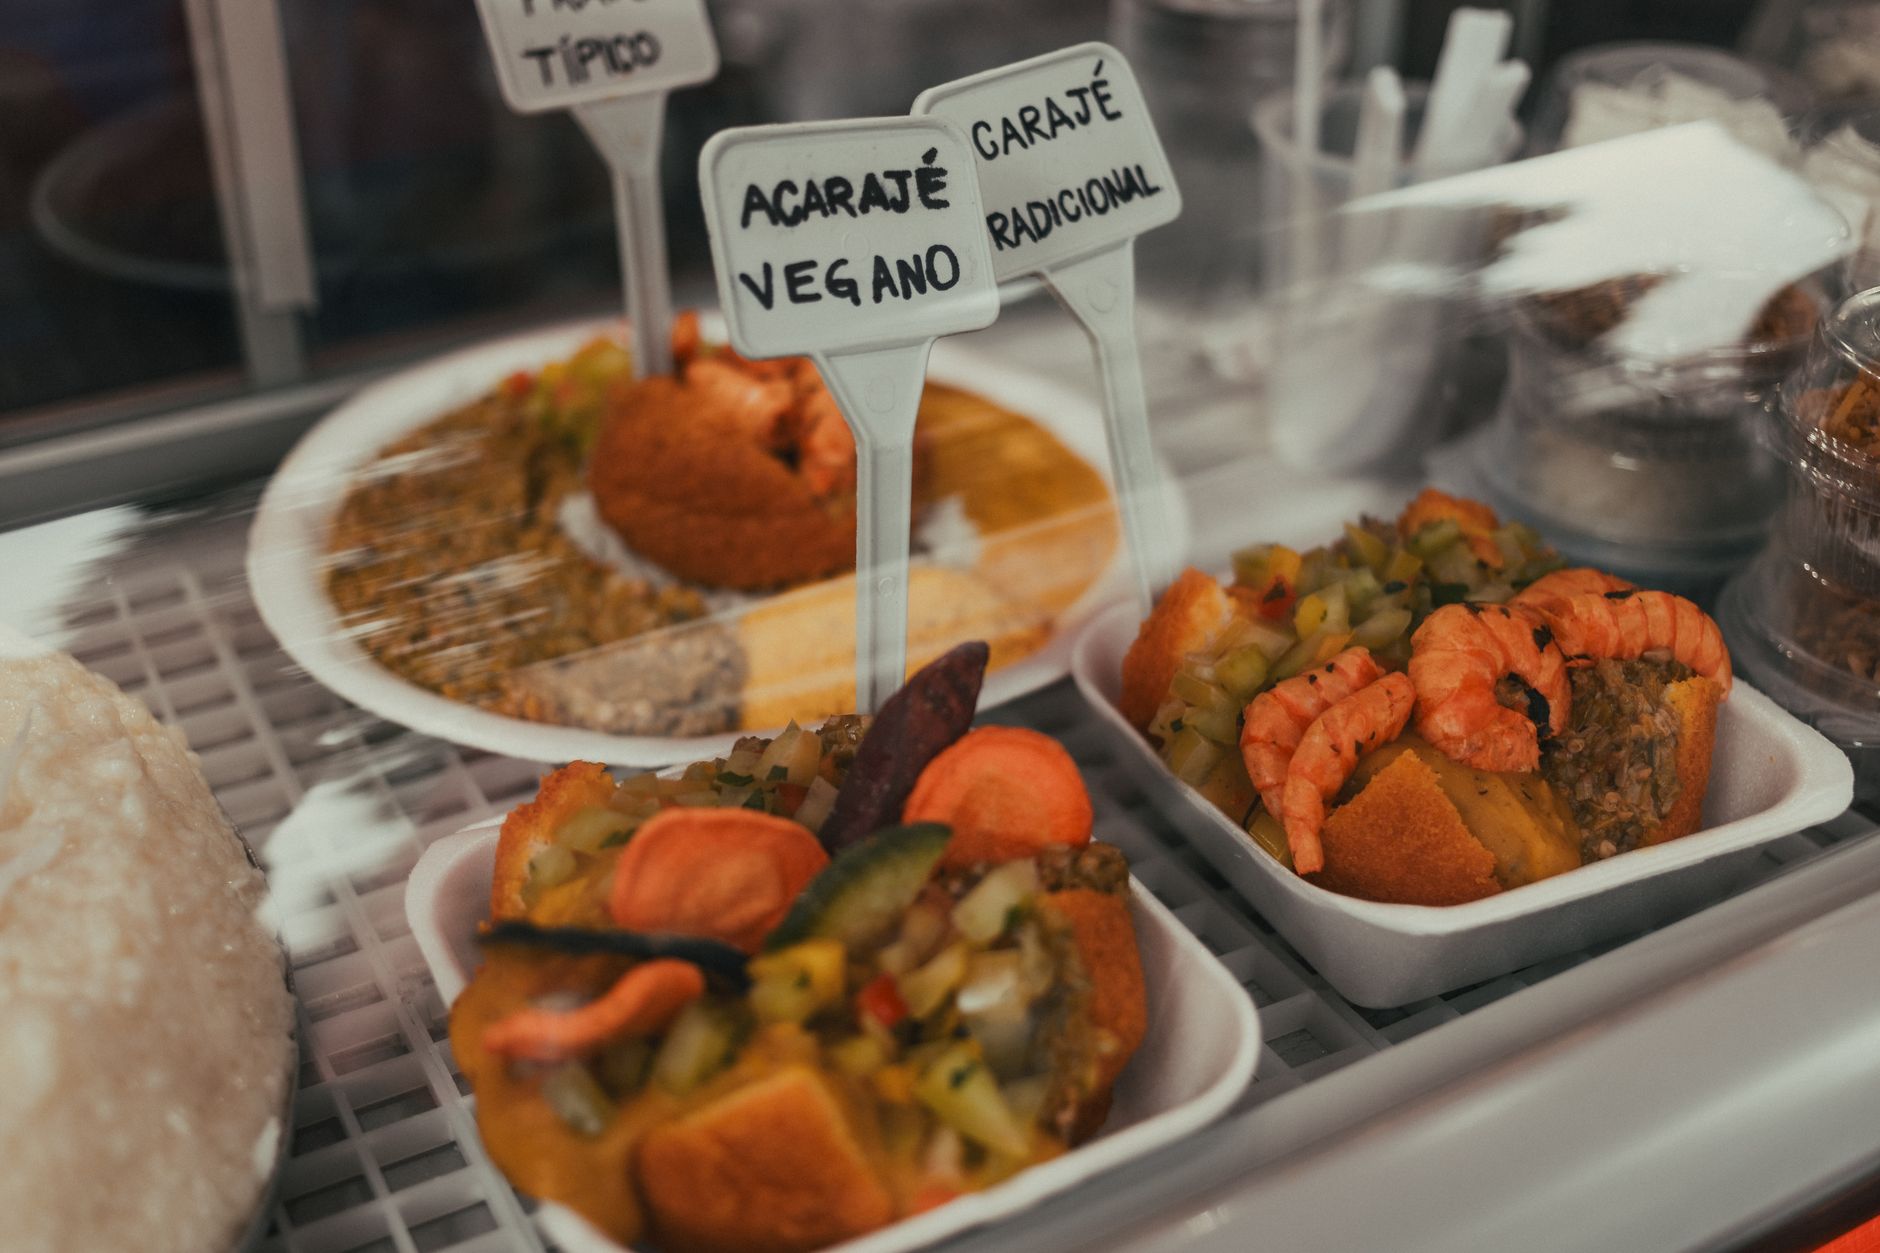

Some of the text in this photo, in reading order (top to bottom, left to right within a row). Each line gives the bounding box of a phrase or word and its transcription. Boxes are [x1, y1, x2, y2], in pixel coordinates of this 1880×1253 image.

[521, 31, 663, 88] TÍPICO
[971, 58, 1123, 161] CARAJÉ
[740, 146, 951, 229] ACARAJÉ
[986, 164, 1162, 251] RADICIONAL
[738, 243, 961, 311] VEGANO
